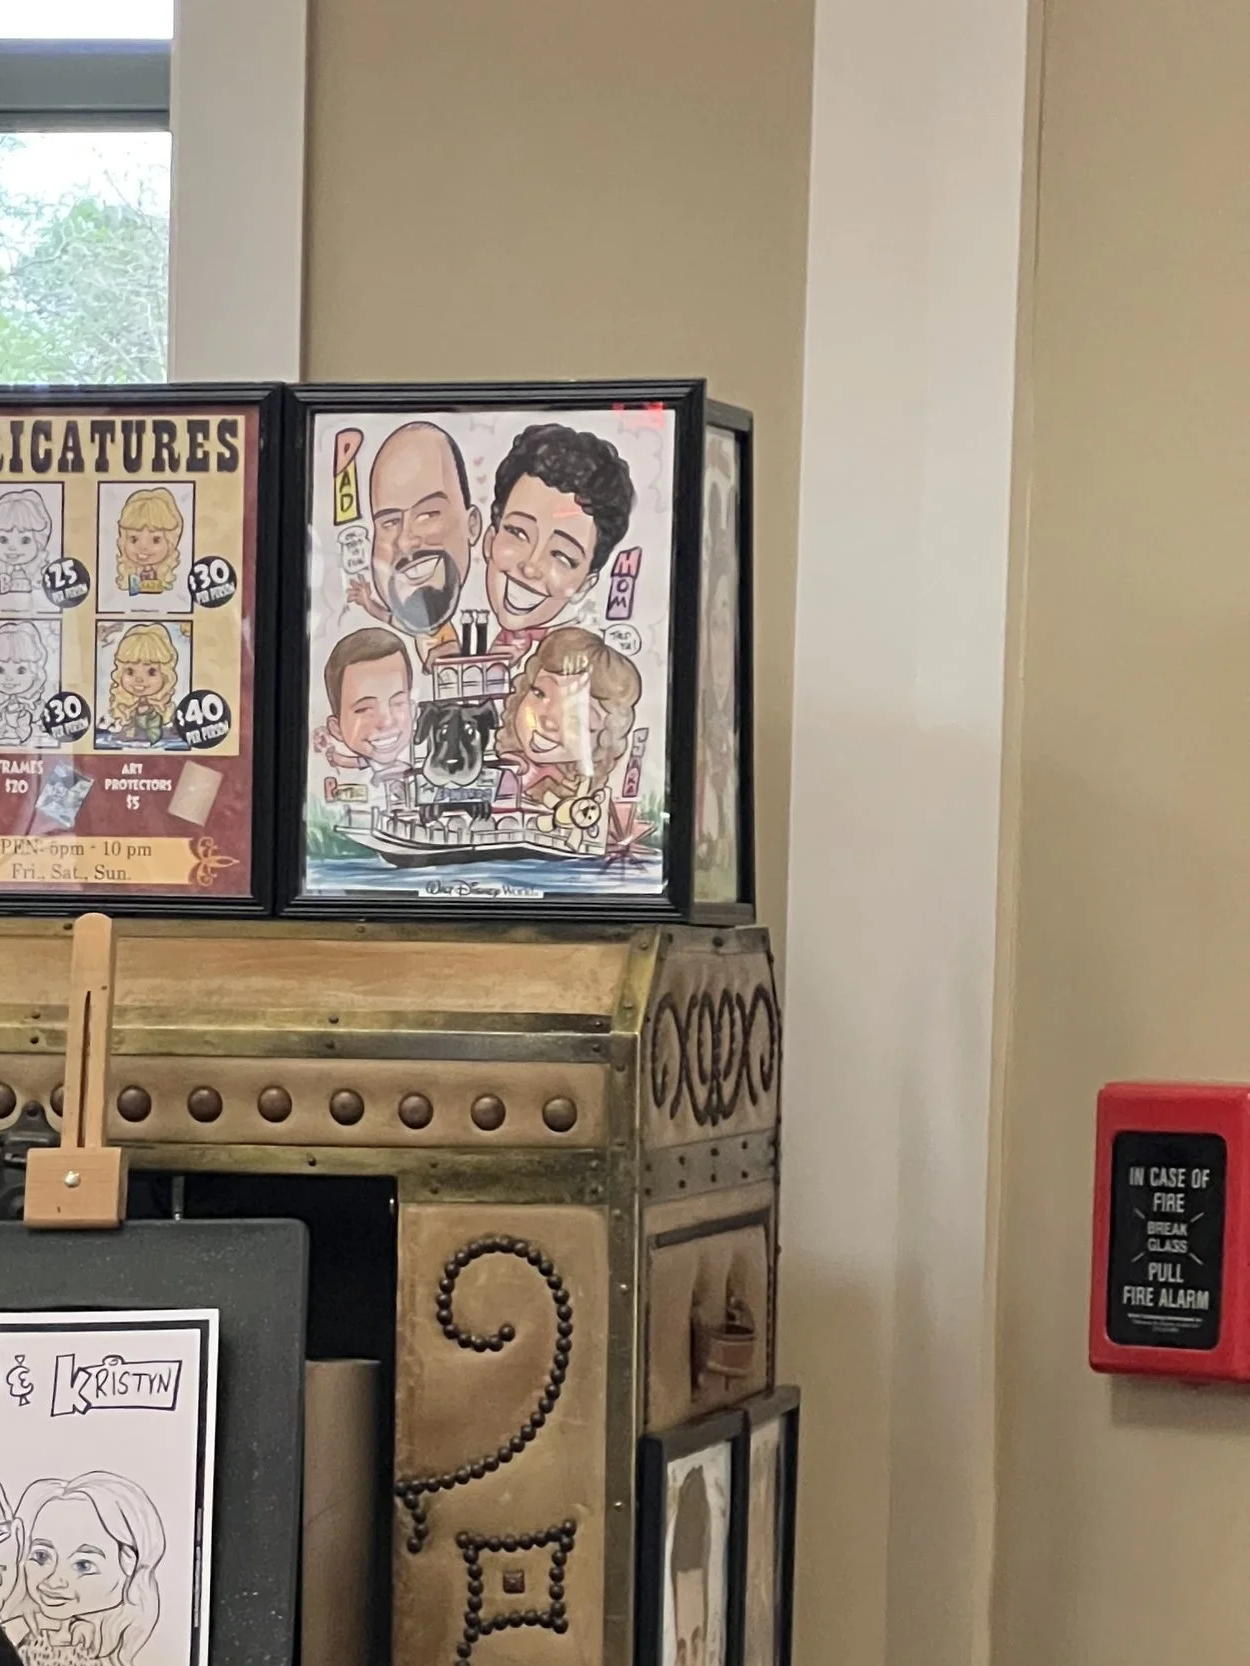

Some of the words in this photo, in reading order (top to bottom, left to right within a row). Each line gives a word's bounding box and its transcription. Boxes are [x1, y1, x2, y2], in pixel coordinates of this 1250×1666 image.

[333, 427, 364, 514] DAD
[43, 560, 79, 589] $25
[189, 559, 230, 590] $30
[608, 545, 643, 612] MOM
[43, 695, 82, 723] $30
[176, 693, 224, 727] $40
[121, 762, 144, 776] ART
[4, 779, 29, 795] $20
[104, 778, 173, 793] PROTECTORS
[126, 794, 141, 811] $5
[103, 840, 122, 857] 10
[126, 844, 152, 861] pm
[94, 864, 132, 881] Sun.
[451, 879, 500, 898] Disney
[1128, 1166, 1145, 1186] IN
[1150, 1167, 1187, 1188] CASE
[1191, 1168, 1211, 1189] OF
[1152, 1192, 1186, 1213] FIRE
[1146, 1220, 1189, 1237] BREAK
[1146, 1238, 1189, 1254] GLASS
[1148, 1261, 1185, 1283] PULL
[1122, 1285, 1154, 1307] FIRE
[1157, 1287, 1210, 1311] ALARM
[50, 1353, 173, 1418] KRISTYN
